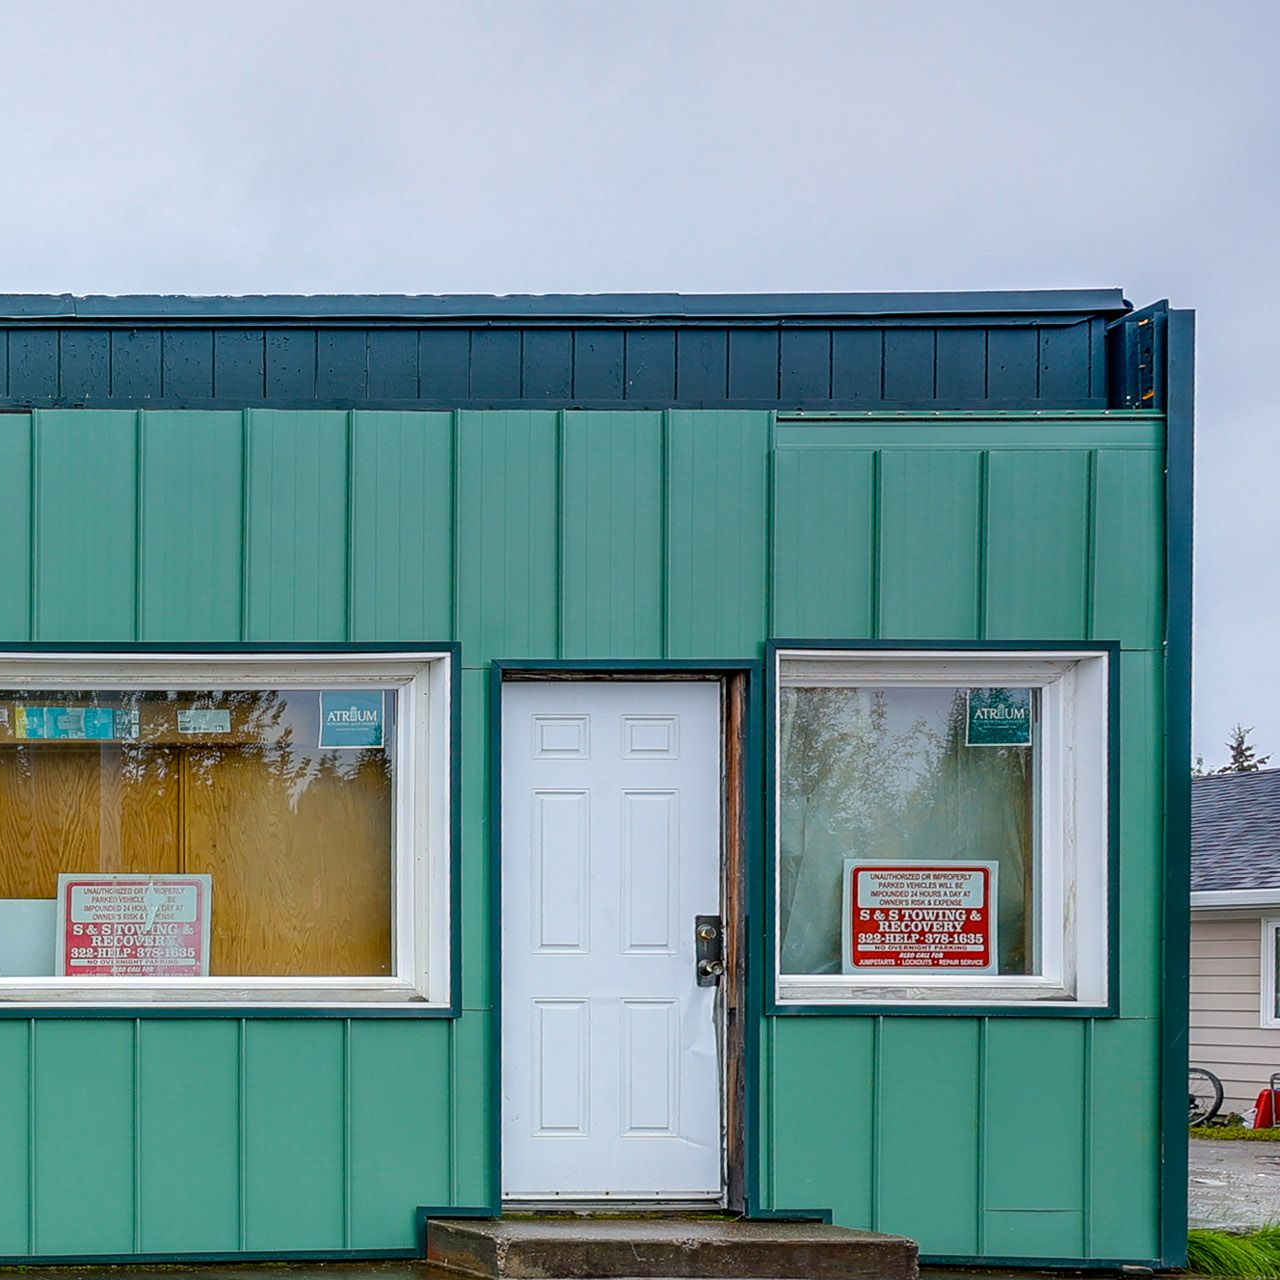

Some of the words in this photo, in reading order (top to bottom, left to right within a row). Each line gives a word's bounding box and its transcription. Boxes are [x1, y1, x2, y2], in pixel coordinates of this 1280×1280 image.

[860, 909, 870, 921] S
[873, 909, 885, 921] &
[889, 909, 899, 921] S
[901, 909, 967, 921] TOWING
[970, 909, 982, 921] &
[73, 924, 83, 935] S
[86, 924, 98, 935] &
[101, 924, 111, 935] S
[183, 924, 194, 935] &
[878, 921, 965, 932] RECOVERY
